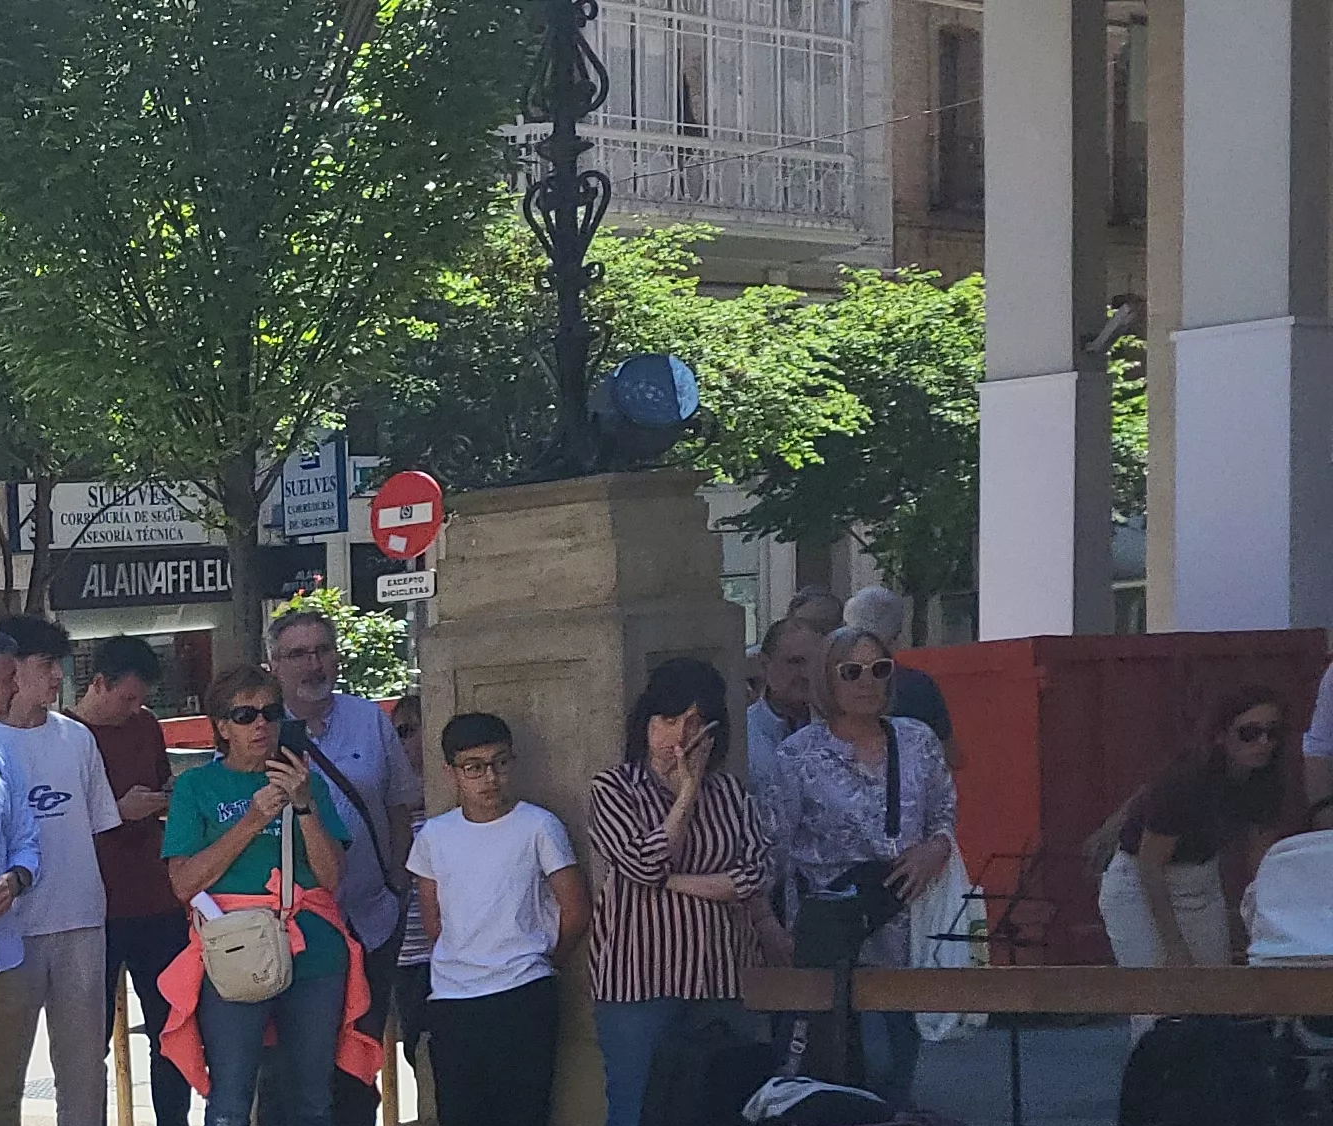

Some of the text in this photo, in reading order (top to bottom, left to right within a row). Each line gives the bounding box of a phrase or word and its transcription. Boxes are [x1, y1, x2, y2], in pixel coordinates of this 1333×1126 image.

[88, 484, 172, 508] SUELVES
[285, 475, 337, 498] SUELVES
[60, 508, 183, 526] CORREDURÍA DE SEGU
[136, 526, 184, 543] TÉCNICA
